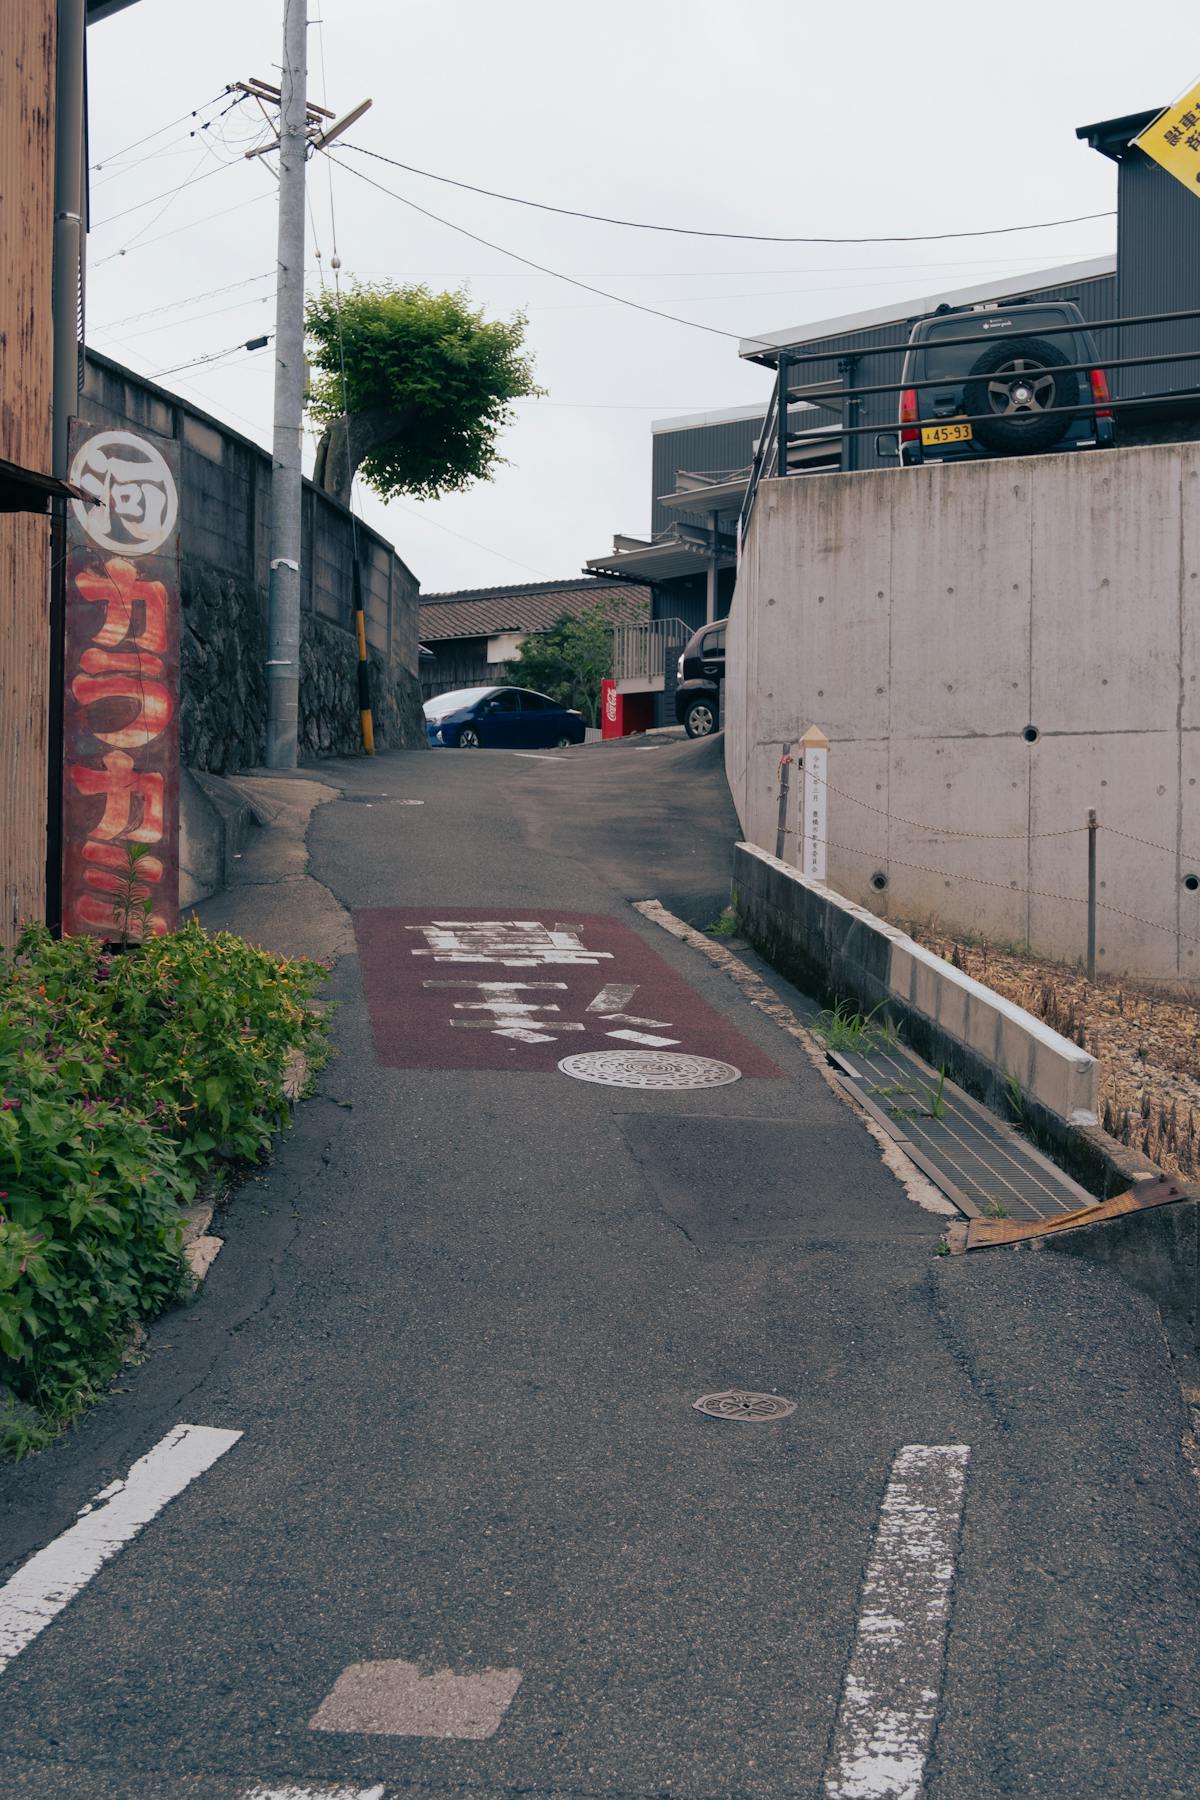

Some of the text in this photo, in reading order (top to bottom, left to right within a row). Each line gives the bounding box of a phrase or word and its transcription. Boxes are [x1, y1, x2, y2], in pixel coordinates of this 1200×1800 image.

[933, 425, 969, 441] 45-93
[71, 557, 174, 938] カラカミ
